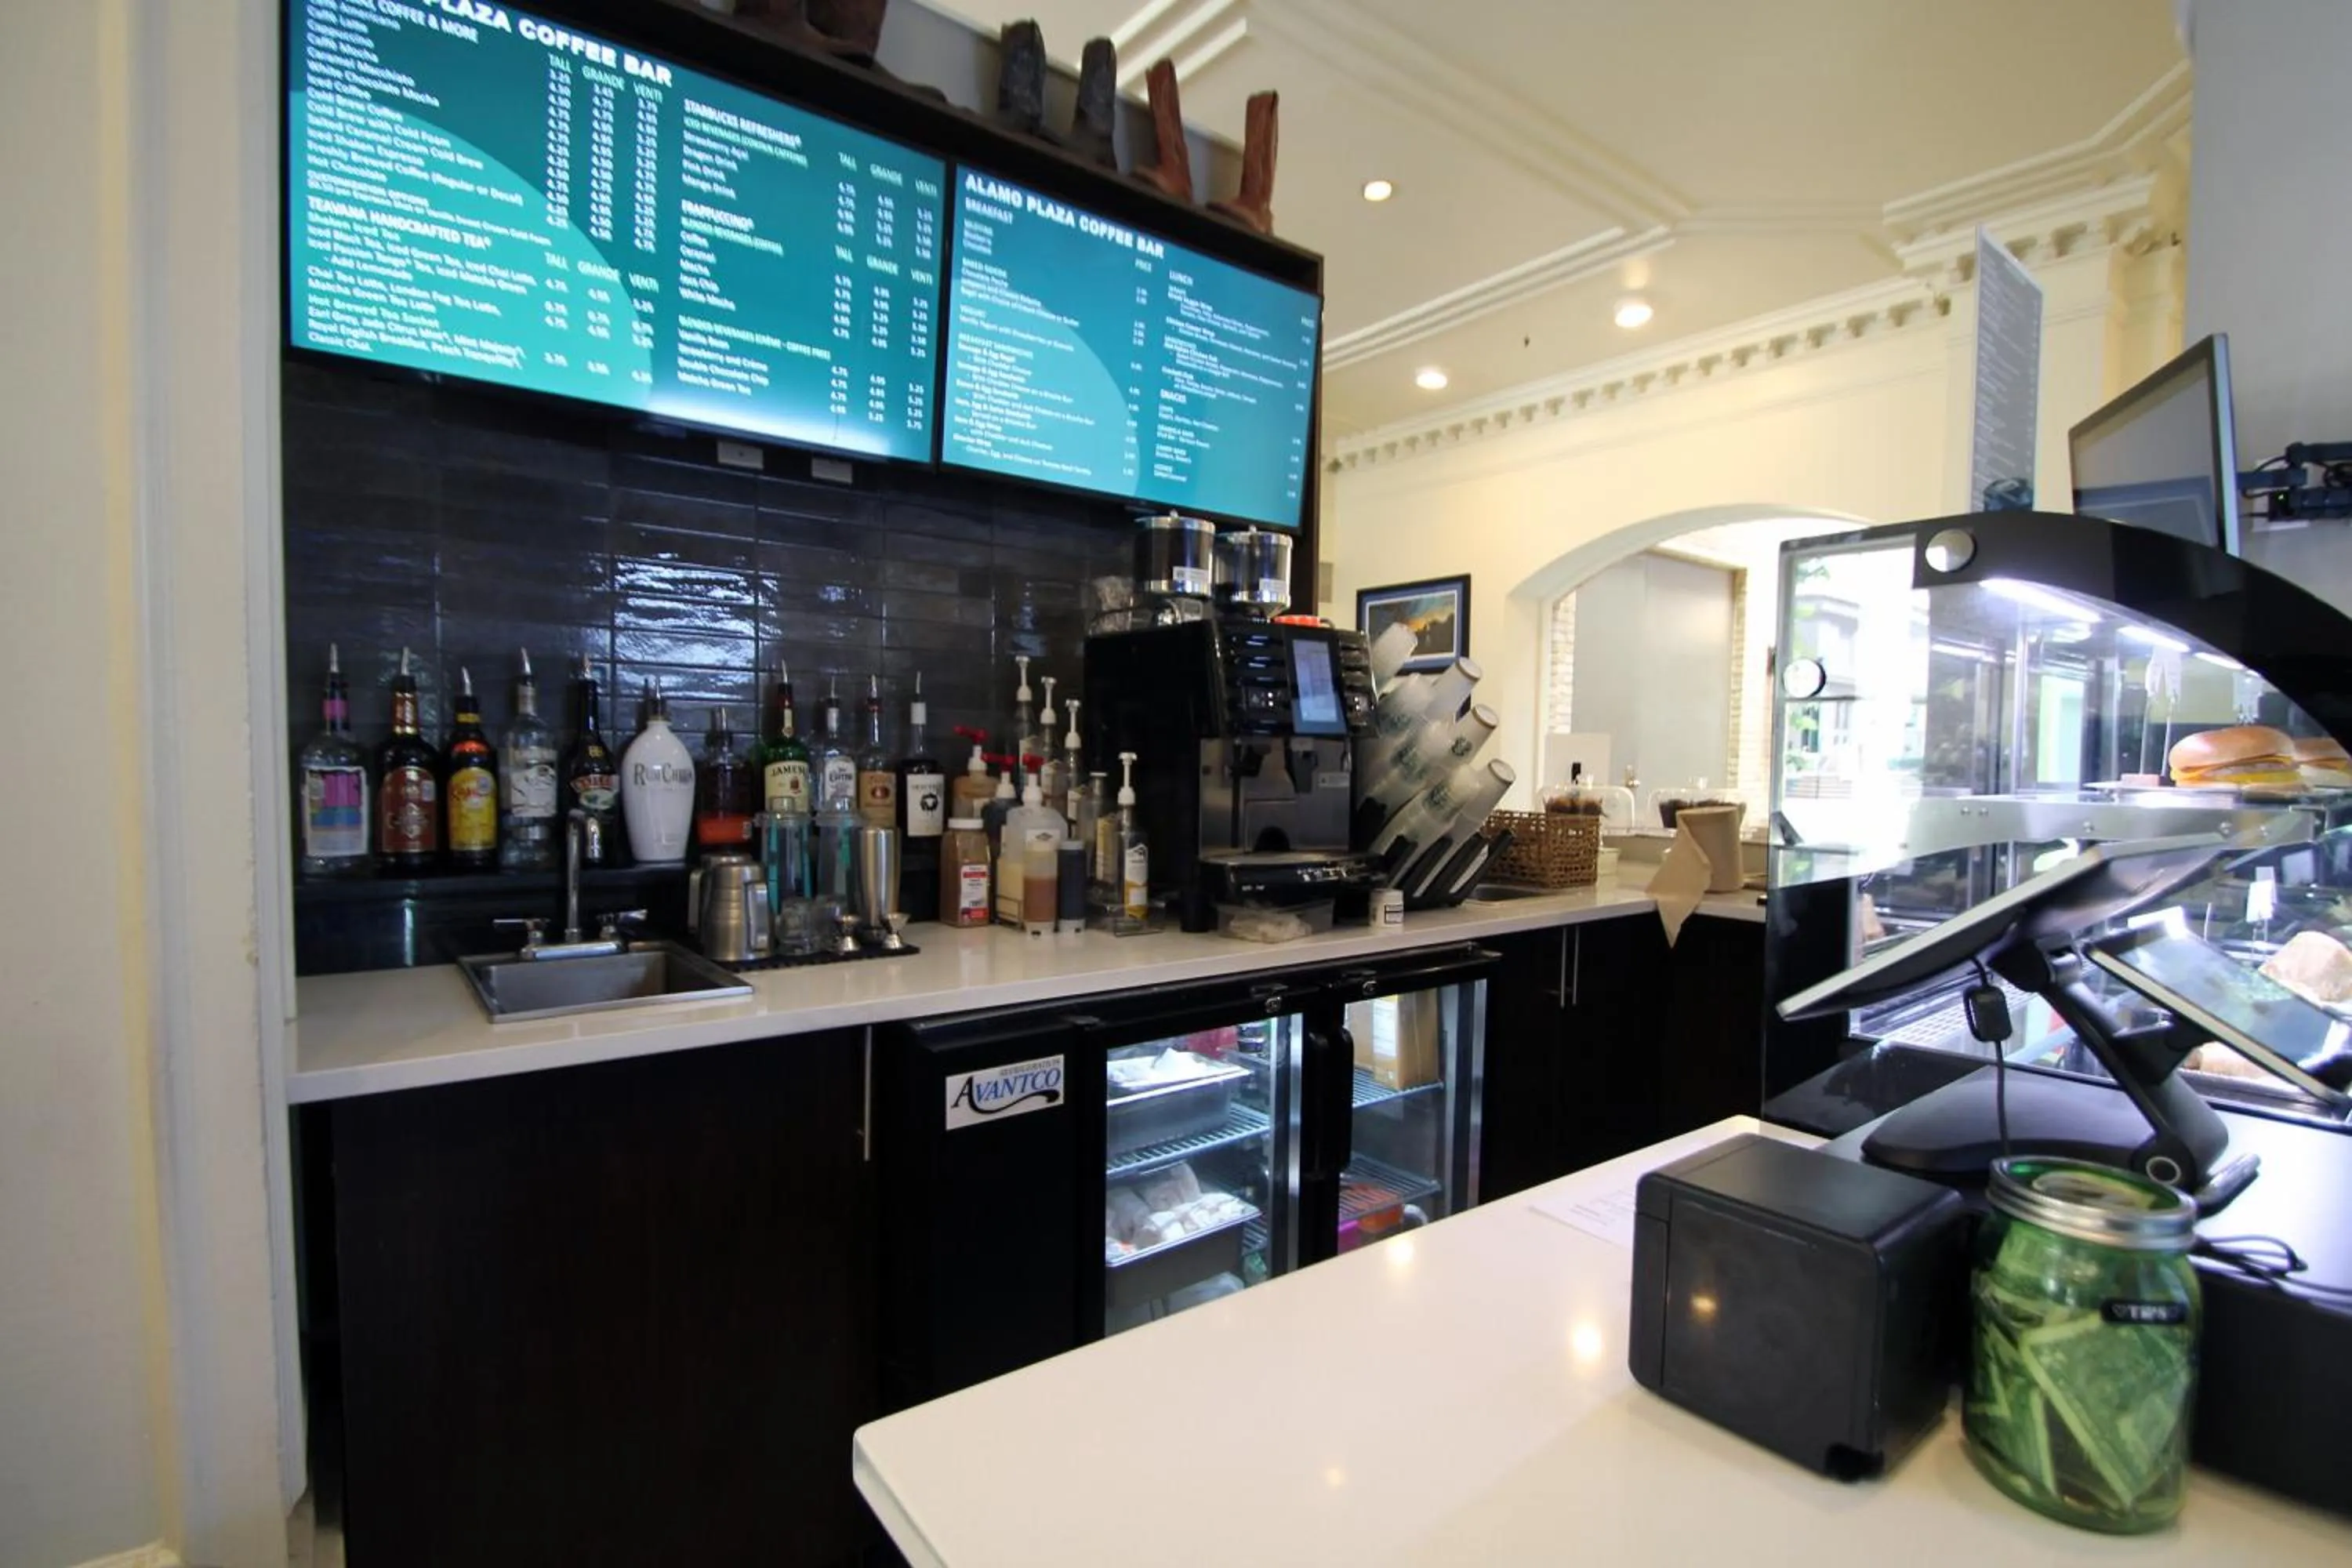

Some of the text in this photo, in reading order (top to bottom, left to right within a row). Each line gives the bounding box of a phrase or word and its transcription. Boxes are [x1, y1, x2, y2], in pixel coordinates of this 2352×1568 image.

[377, 0, 425, 26] COFFEE
[427, 14, 439, 30] &
[441, 19, 477, 42] MORE
[423, 0, 671, 86] LAZA COFFEE BAR
[548, 53, 572, 73] TALL
[582, 66, 624, 90] GRANDE
[633, 82, 662, 102] VENTI
[684, 99, 739, 128] STARBUCKS
[839, 152, 856, 170] TALL
[870, 164, 902, 185] GRANDE
[307, 195, 367, 221] TEAVANA
[370, 211, 460, 243] HANDCRAFTED
[965, 198, 1012, 223] BREAKFAST
[966, 175, 1163, 259] ALAMO PLAZA COFFEE BAR
[545, 252, 568, 270] TALL
[835, 245, 853, 262] TALL
[576, 259, 619, 282] GRANDE
[866, 256, 898, 274] GRANDE
[629, 273, 659, 292] VENTI
[911, 269, 932, 284] VENTI
[1169, 270, 1192, 285] LUNCH
[1160, 389, 1186, 403] SNACKS
[950, 1068, 1062, 1112] AVANTCO
